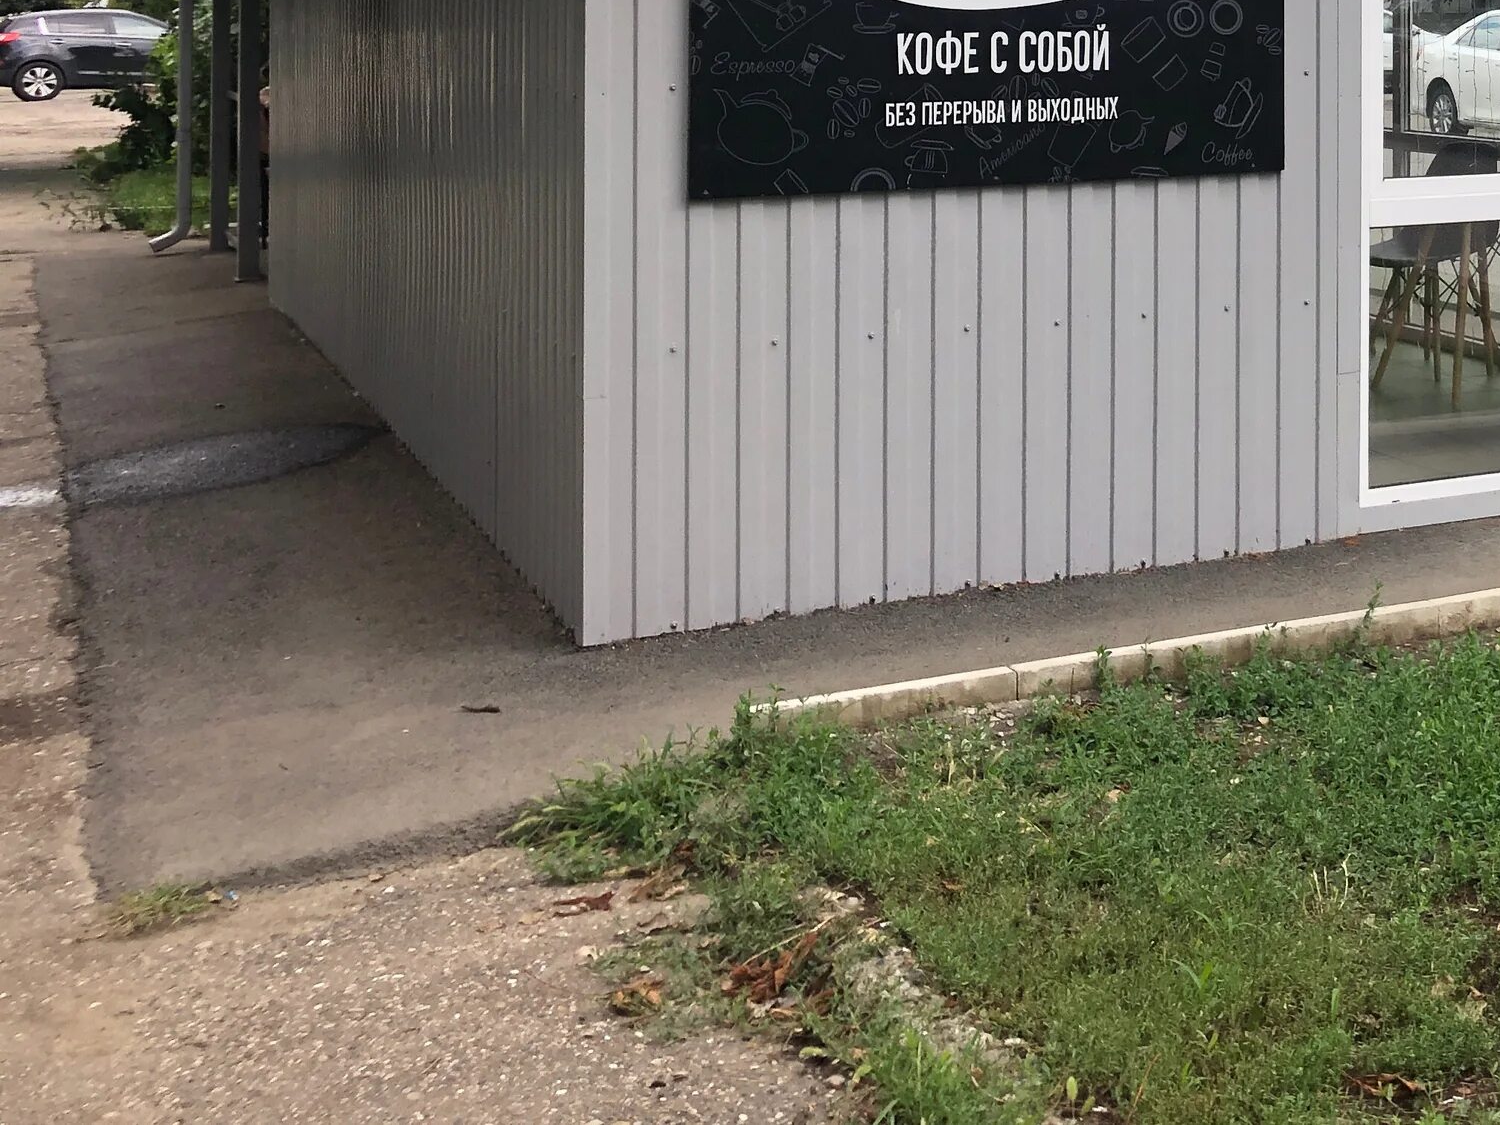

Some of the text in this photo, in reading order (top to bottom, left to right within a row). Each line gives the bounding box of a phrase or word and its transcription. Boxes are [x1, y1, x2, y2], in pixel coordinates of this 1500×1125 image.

[896, 23, 1110, 76] КОФЕ С СОБОЙ
[710, 50, 796, 82] Espresso
[885, 96, 1119, 127] БЕЗ ПЕРЕРЫВА И ВЫХОДНЫХ
[1201, 140, 1253, 166] Coffee
